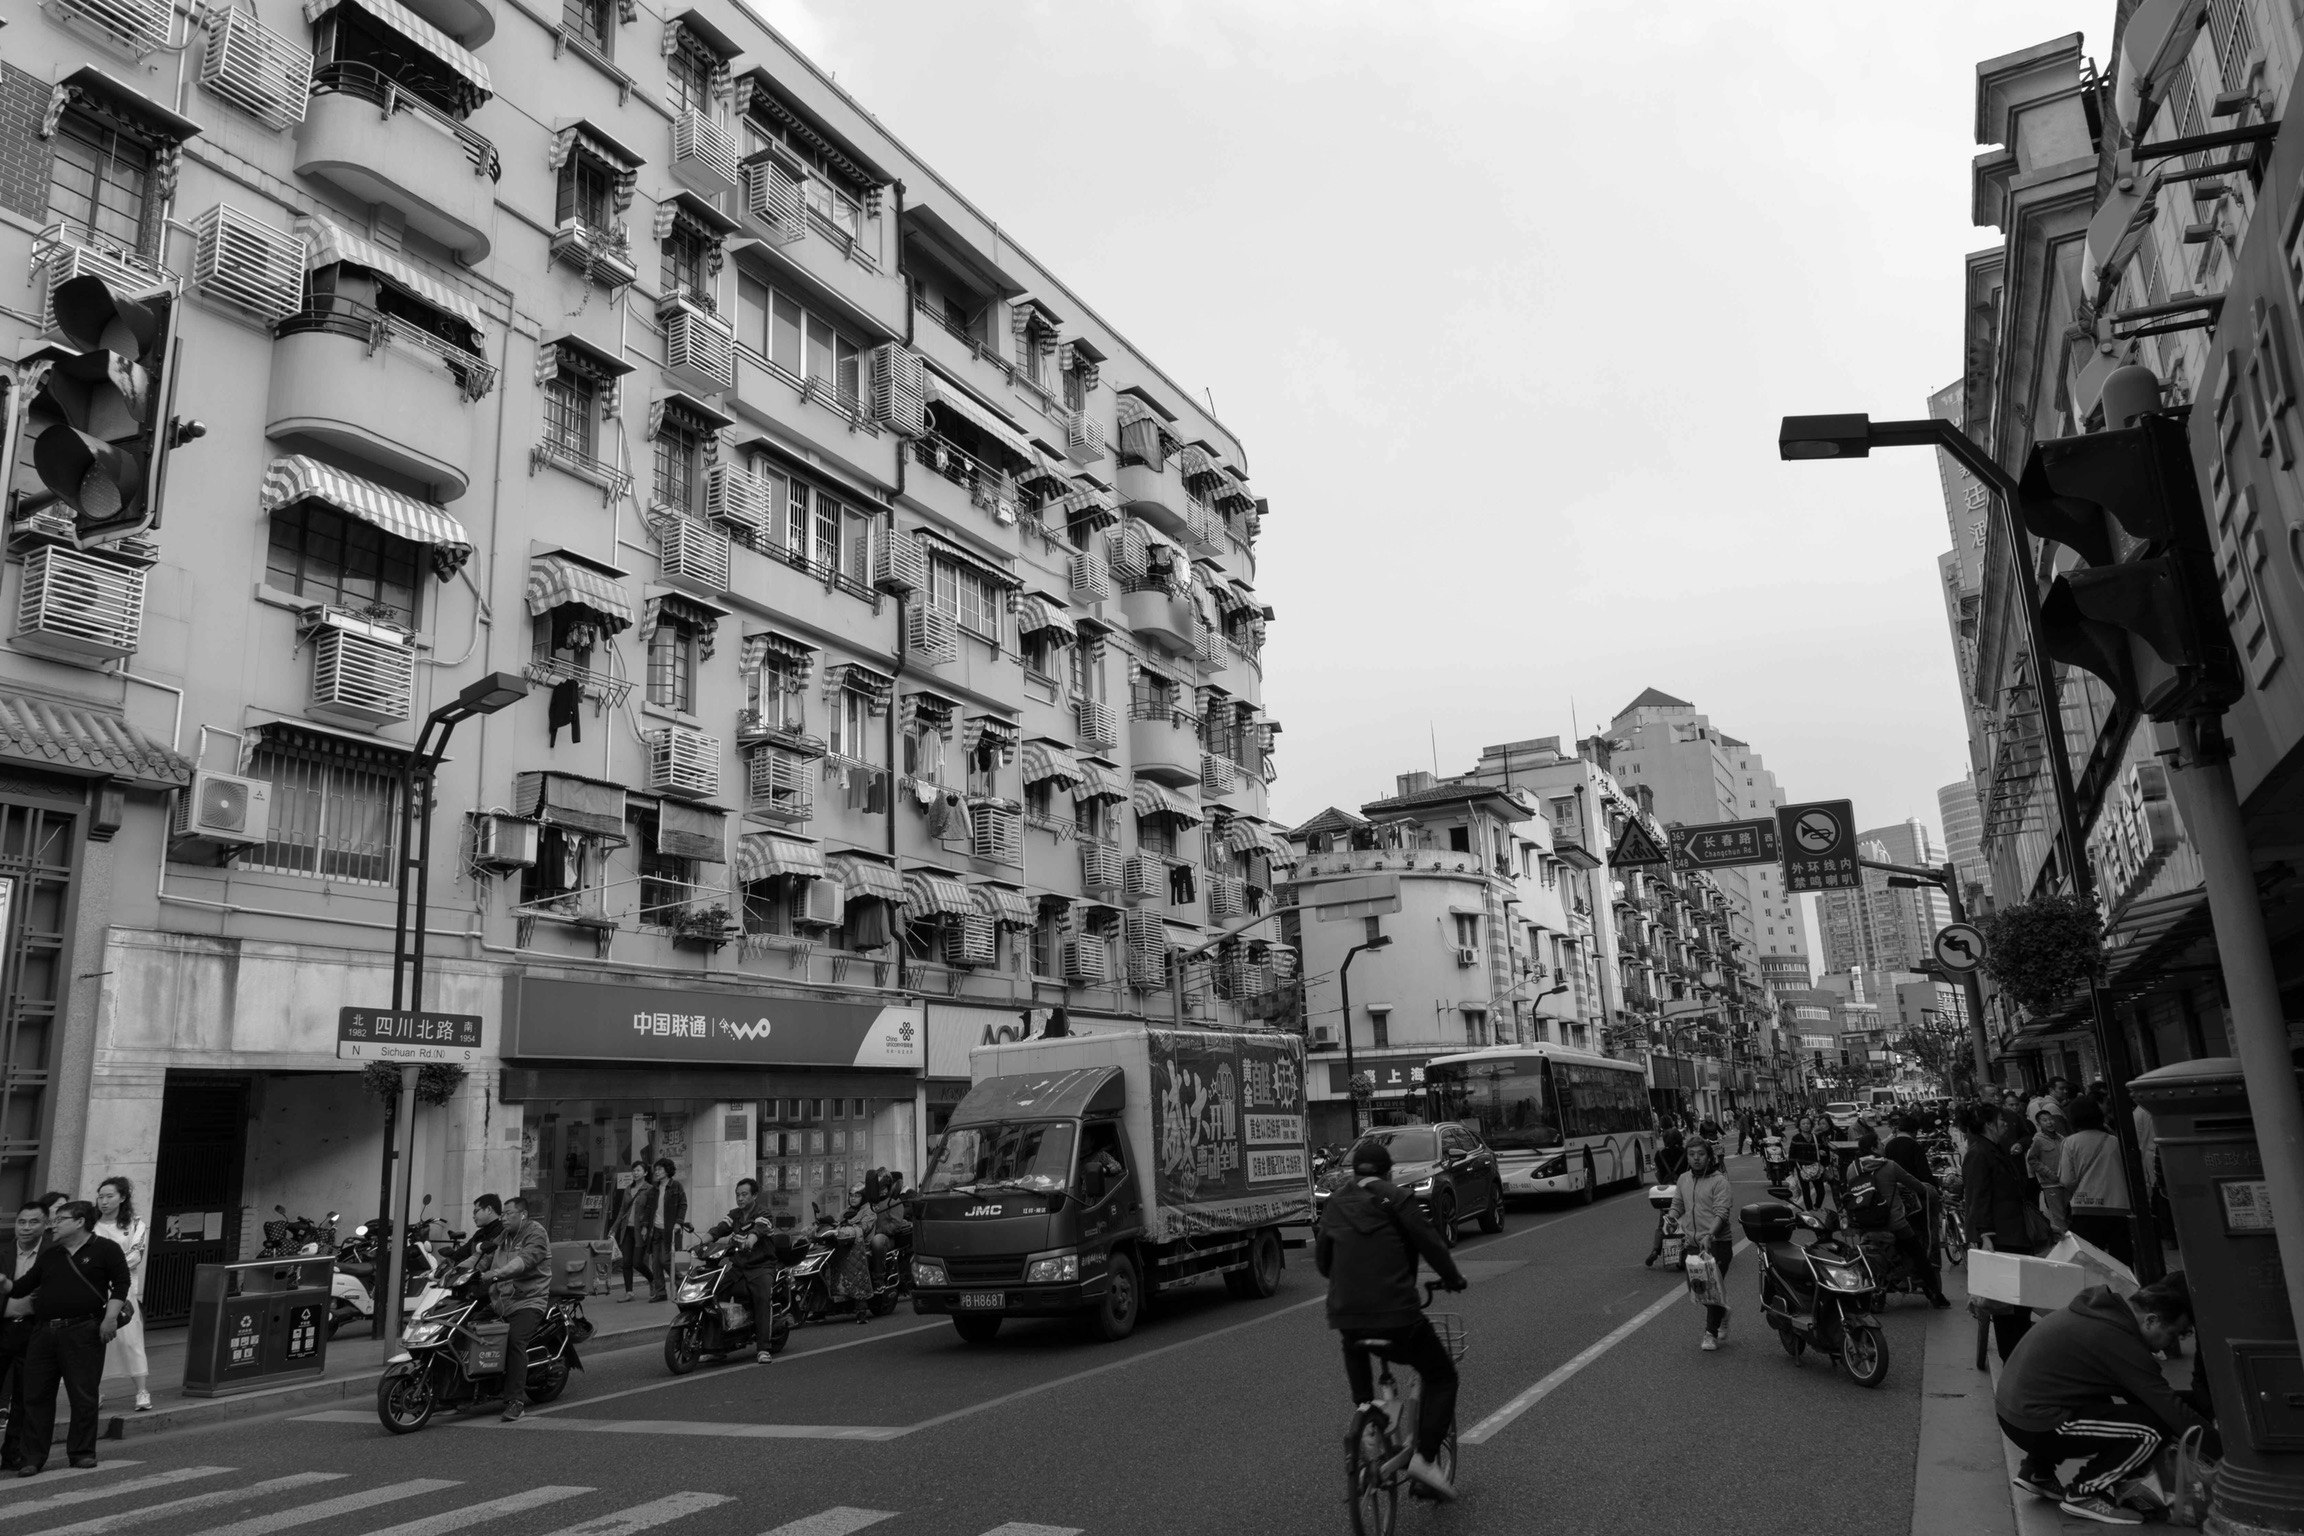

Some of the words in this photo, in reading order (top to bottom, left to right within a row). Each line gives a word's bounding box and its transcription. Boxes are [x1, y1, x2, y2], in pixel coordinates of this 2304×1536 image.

[1671, 831, 1685, 841] 365
[1703, 832, 1751, 848] 长春路
[1763, 833, 1773, 843] 西
[1704, 848, 1741, 858] Changchun
[1674, 859, 1689, 869] 348
[1791, 857, 1852, 874] 外环线内
[1793, 873, 1854, 889] 禁鸣喇叭
[352, 1013, 364, 1026] 北
[633, 1011, 706, 1038] 中国联通
[348, 1028, 367, 1038] 1982
[375, 1016, 454, 1041] 四川北路
[463, 1021, 473, 1033] 南
[459, 1034, 476, 1043] 1954
[352, 1045, 360, 1055] N
[381, 1046, 415, 1058] Sichuan
[464, 1051, 471, 1060] S
[964, 1204, 1003, 1217] JMC
